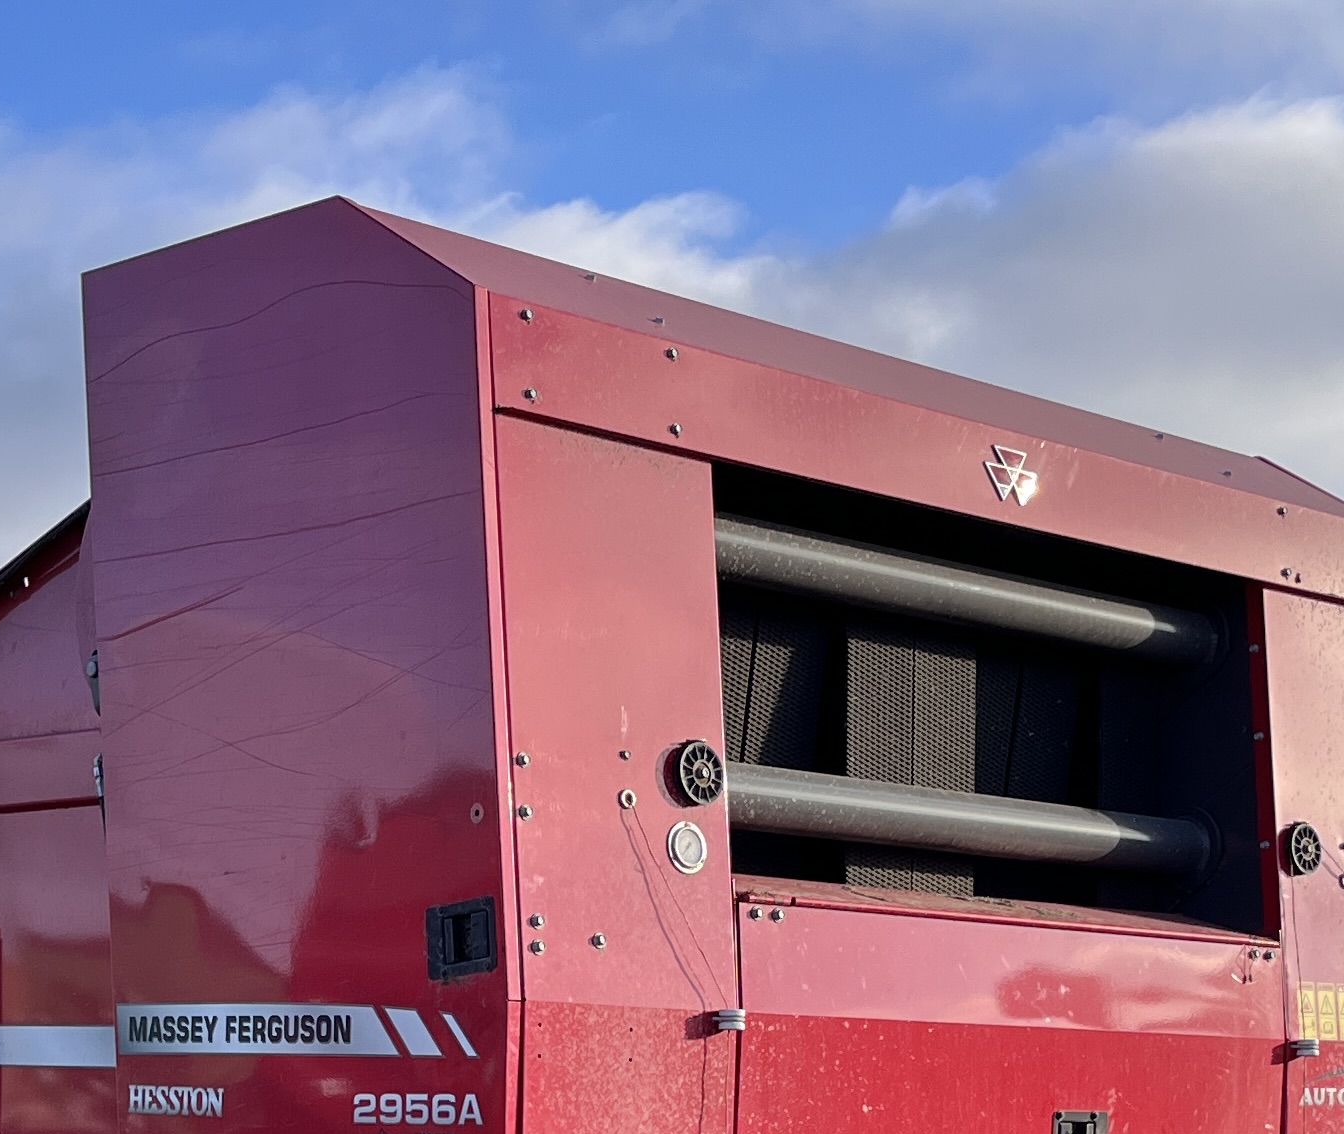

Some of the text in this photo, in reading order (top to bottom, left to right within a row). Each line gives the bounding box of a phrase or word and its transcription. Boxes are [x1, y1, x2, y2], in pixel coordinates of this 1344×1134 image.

[128, 1015, 352, 1044] MASSEY FERGUSON
[128, 1084, 224, 1118] HESSTON
[352, 1092, 484, 1125] 2956A
